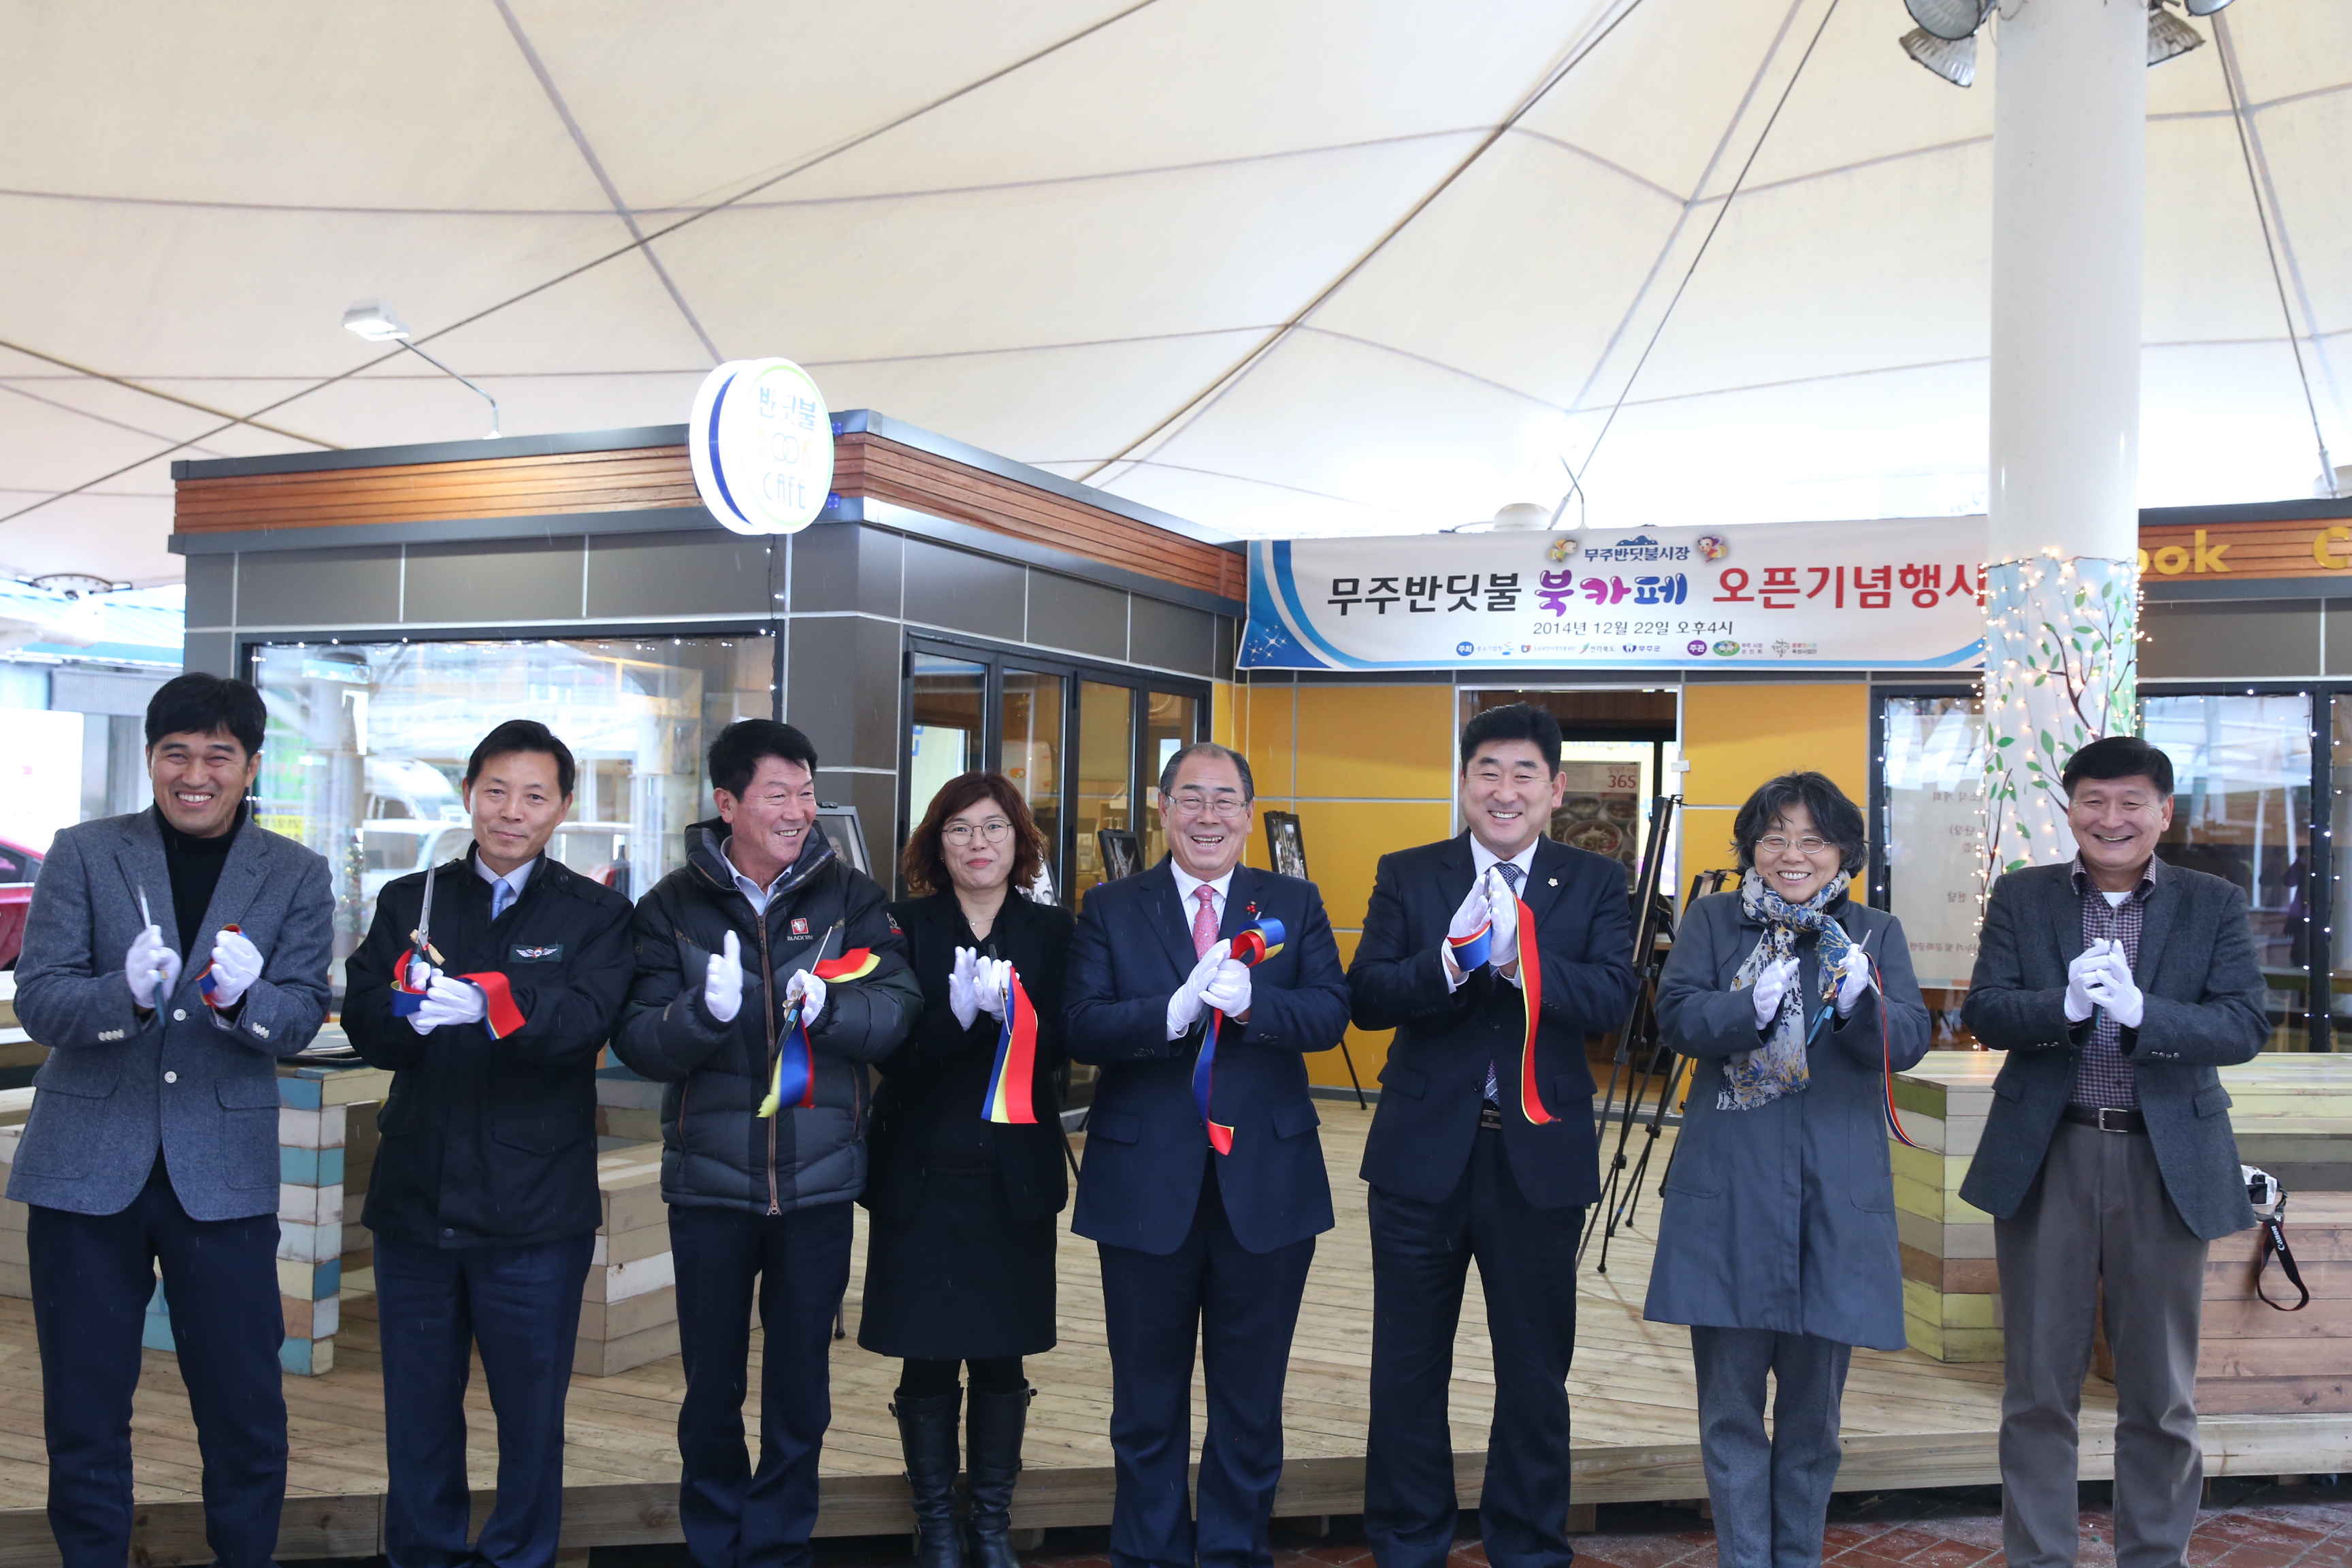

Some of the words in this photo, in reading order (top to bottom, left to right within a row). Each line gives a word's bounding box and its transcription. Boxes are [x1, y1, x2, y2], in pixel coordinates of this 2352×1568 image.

[759, 386, 816, 431] 반딧불
[758, 425, 812, 470] BOOK
[762, 470, 806, 510] CAFE
[1584, 544, 1690, 564] 무주반딧불시장
[1327, 572, 1523, 616] 무주반딧불
[1534, 570, 1688, 618] 북카페
[1712, 563, 1986, 610] 오픈기념행사
[1533, 621, 1588, 636] 2014년
[1593, 621, 1628, 636] 12월
[1633, 621, 1669, 636] 22일
[1676, 620, 1734, 636] 오후4시
[1458, 644, 1473, 653] 주최
[1590, 644, 1616, 653] 전라북도
[1689, 644, 1705, 653] 주관
[1607, 774, 1637, 789] 365
[2270, 1225, 2285, 1251] Canon
